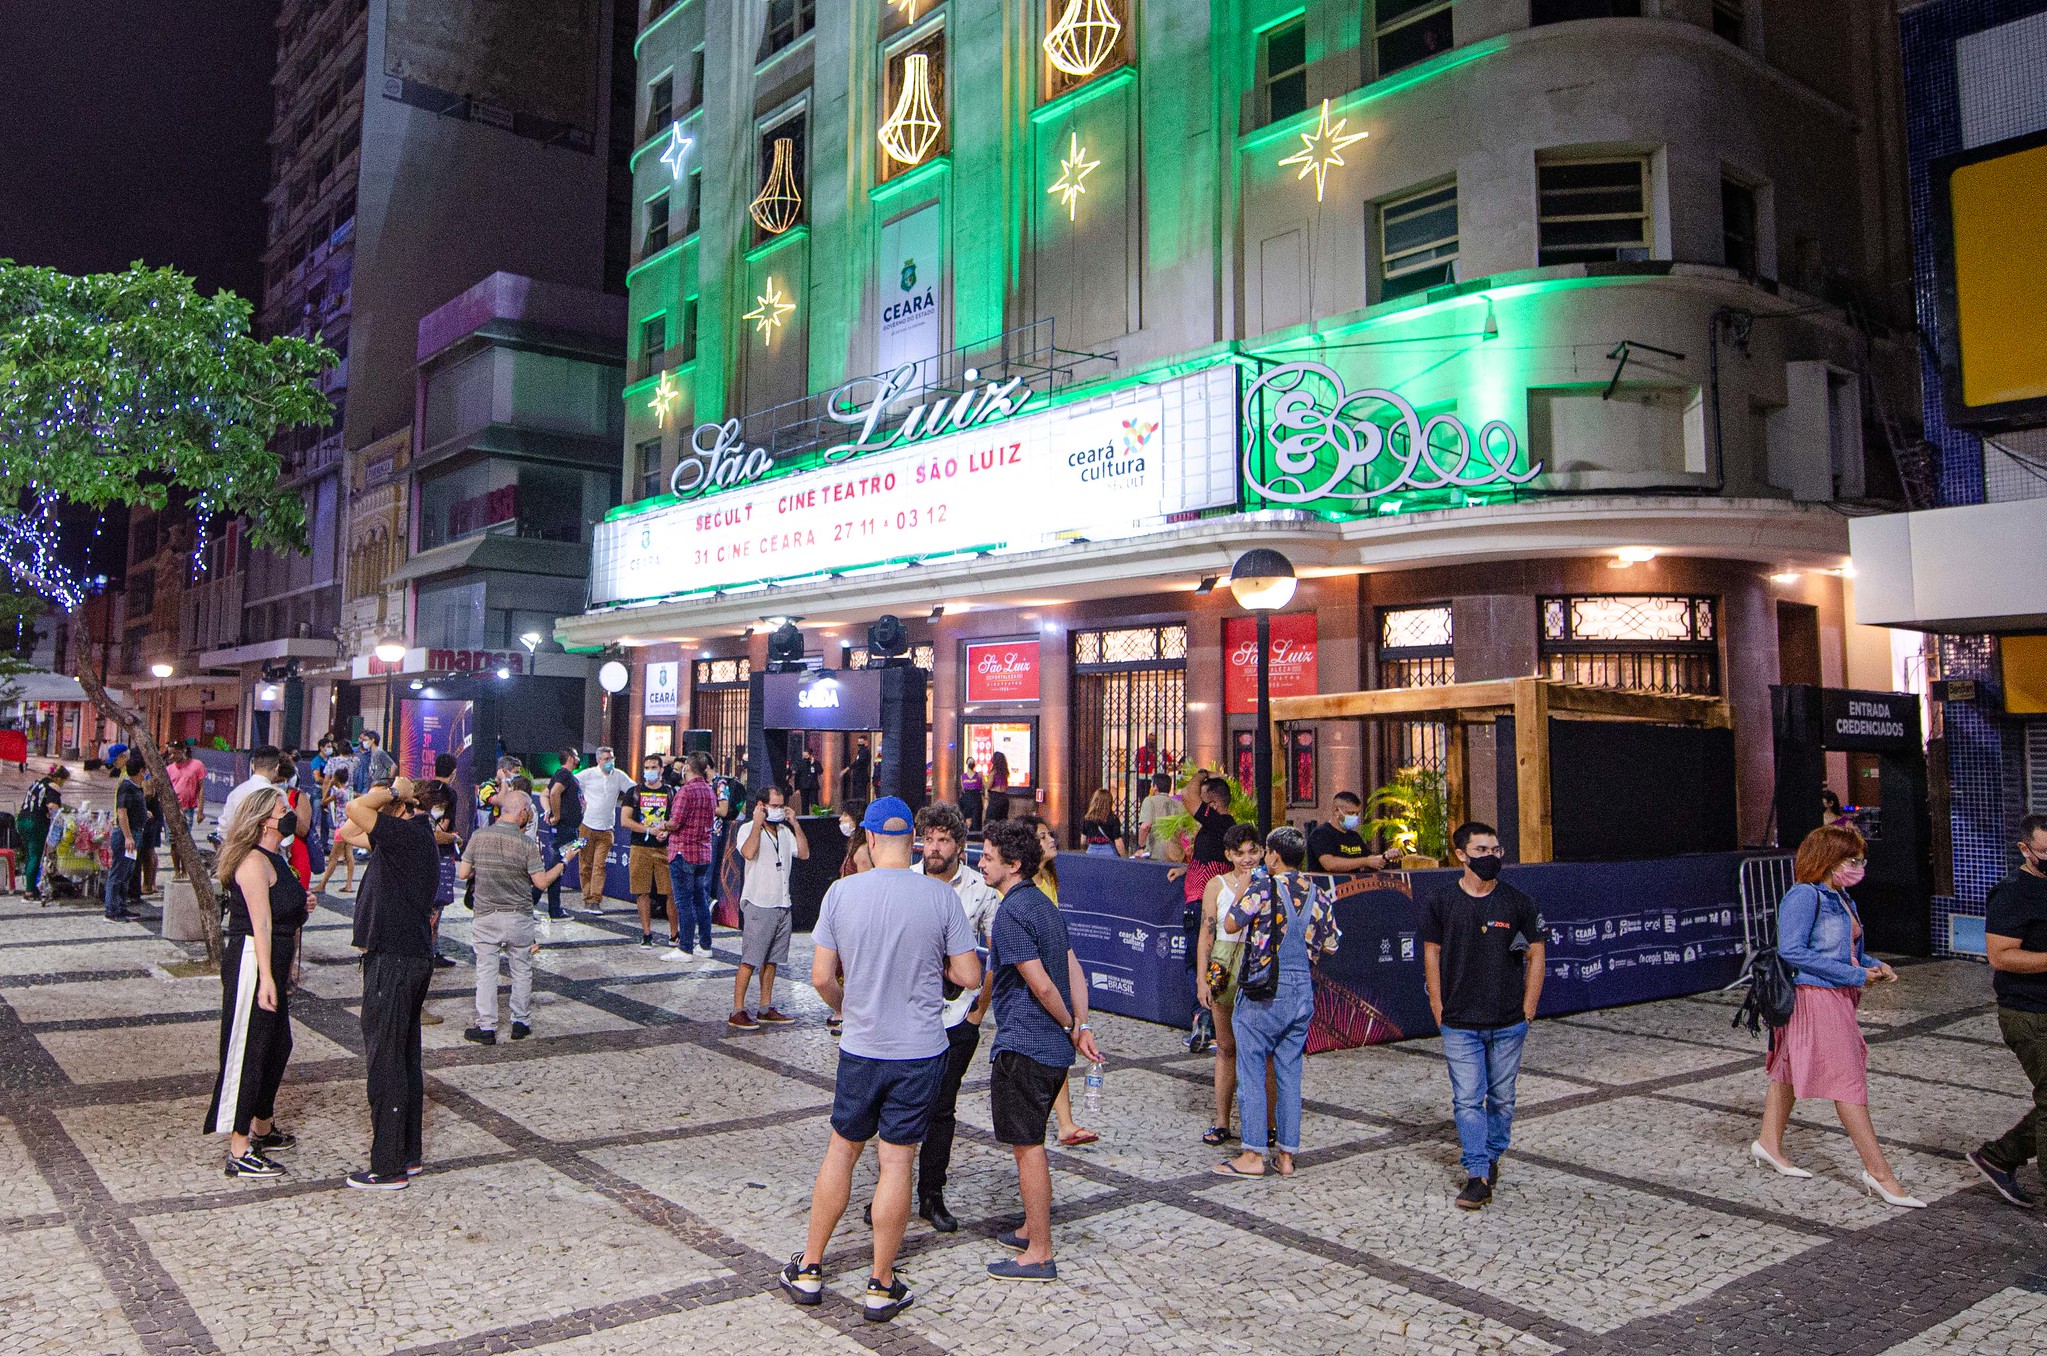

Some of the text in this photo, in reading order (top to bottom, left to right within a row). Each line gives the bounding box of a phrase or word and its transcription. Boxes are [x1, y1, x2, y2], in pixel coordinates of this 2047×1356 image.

[883, 286, 934, 322] CEARÁ
[670, 361, 1034, 500] São Luiz
[1068, 439, 1114, 467] ceará
[1081, 457, 1145, 482] cultura
[696, 504, 753, 532] SECULT
[916, 457, 958, 484] SÃO
[969, 443, 1021, 472] LUIZ
[694, 549, 708, 565] 31
[717, 540, 751, 562] CINE
[978, 652, 1031, 674] São Luiz
[1232, 639, 1313, 666] Sã Luiz
[650, 688, 675, 703] CEARÁ
[798, 689, 839, 708] SADA
[1849, 700, 1890, 719] ENTRADA
[1836, 719, 1904, 737] CREDENCIADOS
[1575, 924, 1597, 938] CEARÁ
[1581, 959, 1602, 975] CEARÁ
[1108, 980, 1134, 994] BRASIL
